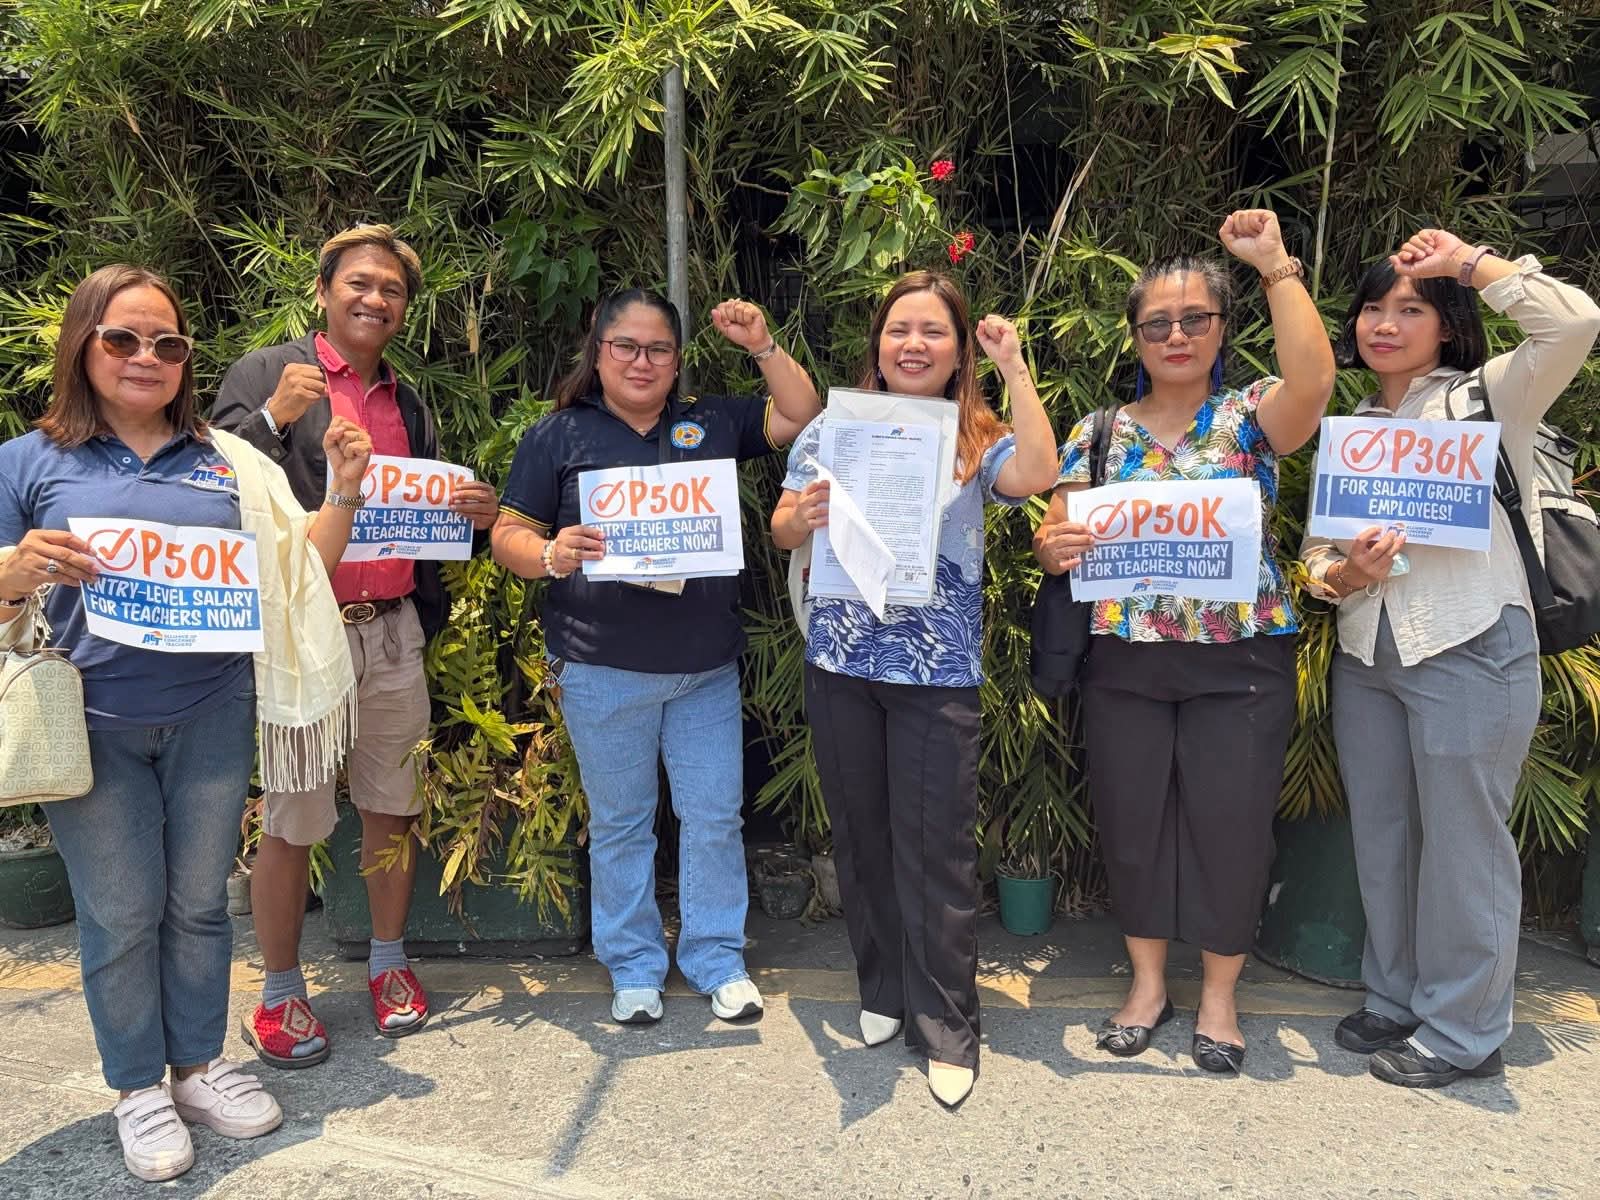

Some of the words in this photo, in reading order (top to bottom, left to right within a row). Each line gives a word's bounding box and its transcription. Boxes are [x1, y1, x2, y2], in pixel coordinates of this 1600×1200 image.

[1391, 428, 1486, 481] P36K
[628, 476, 716, 517] P50K
[1339, 478, 1368, 496] FOR
[1372, 479, 1424, 499] SALARY
[1427, 483, 1472, 504] GRADE
[1476, 489, 1482, 504] 1
[354, 510, 419, 524] TRY-LEVEL
[1131, 496, 1227, 539] P50K
[1368, 498, 1453, 521] EMPLOYEES!
[364, 525, 428, 540] TEACHERS
[431, 526, 465, 540] NOW!
[672, 518, 718, 534] SALARY
[618, 536, 680, 553] TEACHERS
[683, 534, 717, 551] NOW!
[1086, 543, 1173, 561] ENTRY-LEVEL
[1176, 543, 1229, 559] SALARY
[140, 530, 250, 585] P50K
[1087, 562, 1113, 578] FOR
[1116, 560, 1183, 576] TEACHERS
[1187, 560, 1225, 577] NOW!
[193, 591, 253, 607] SALARY
[90, 594, 117, 616] FOR
[121, 601, 202, 627] TEACHERS
[207, 610, 252, 628] NOW!
